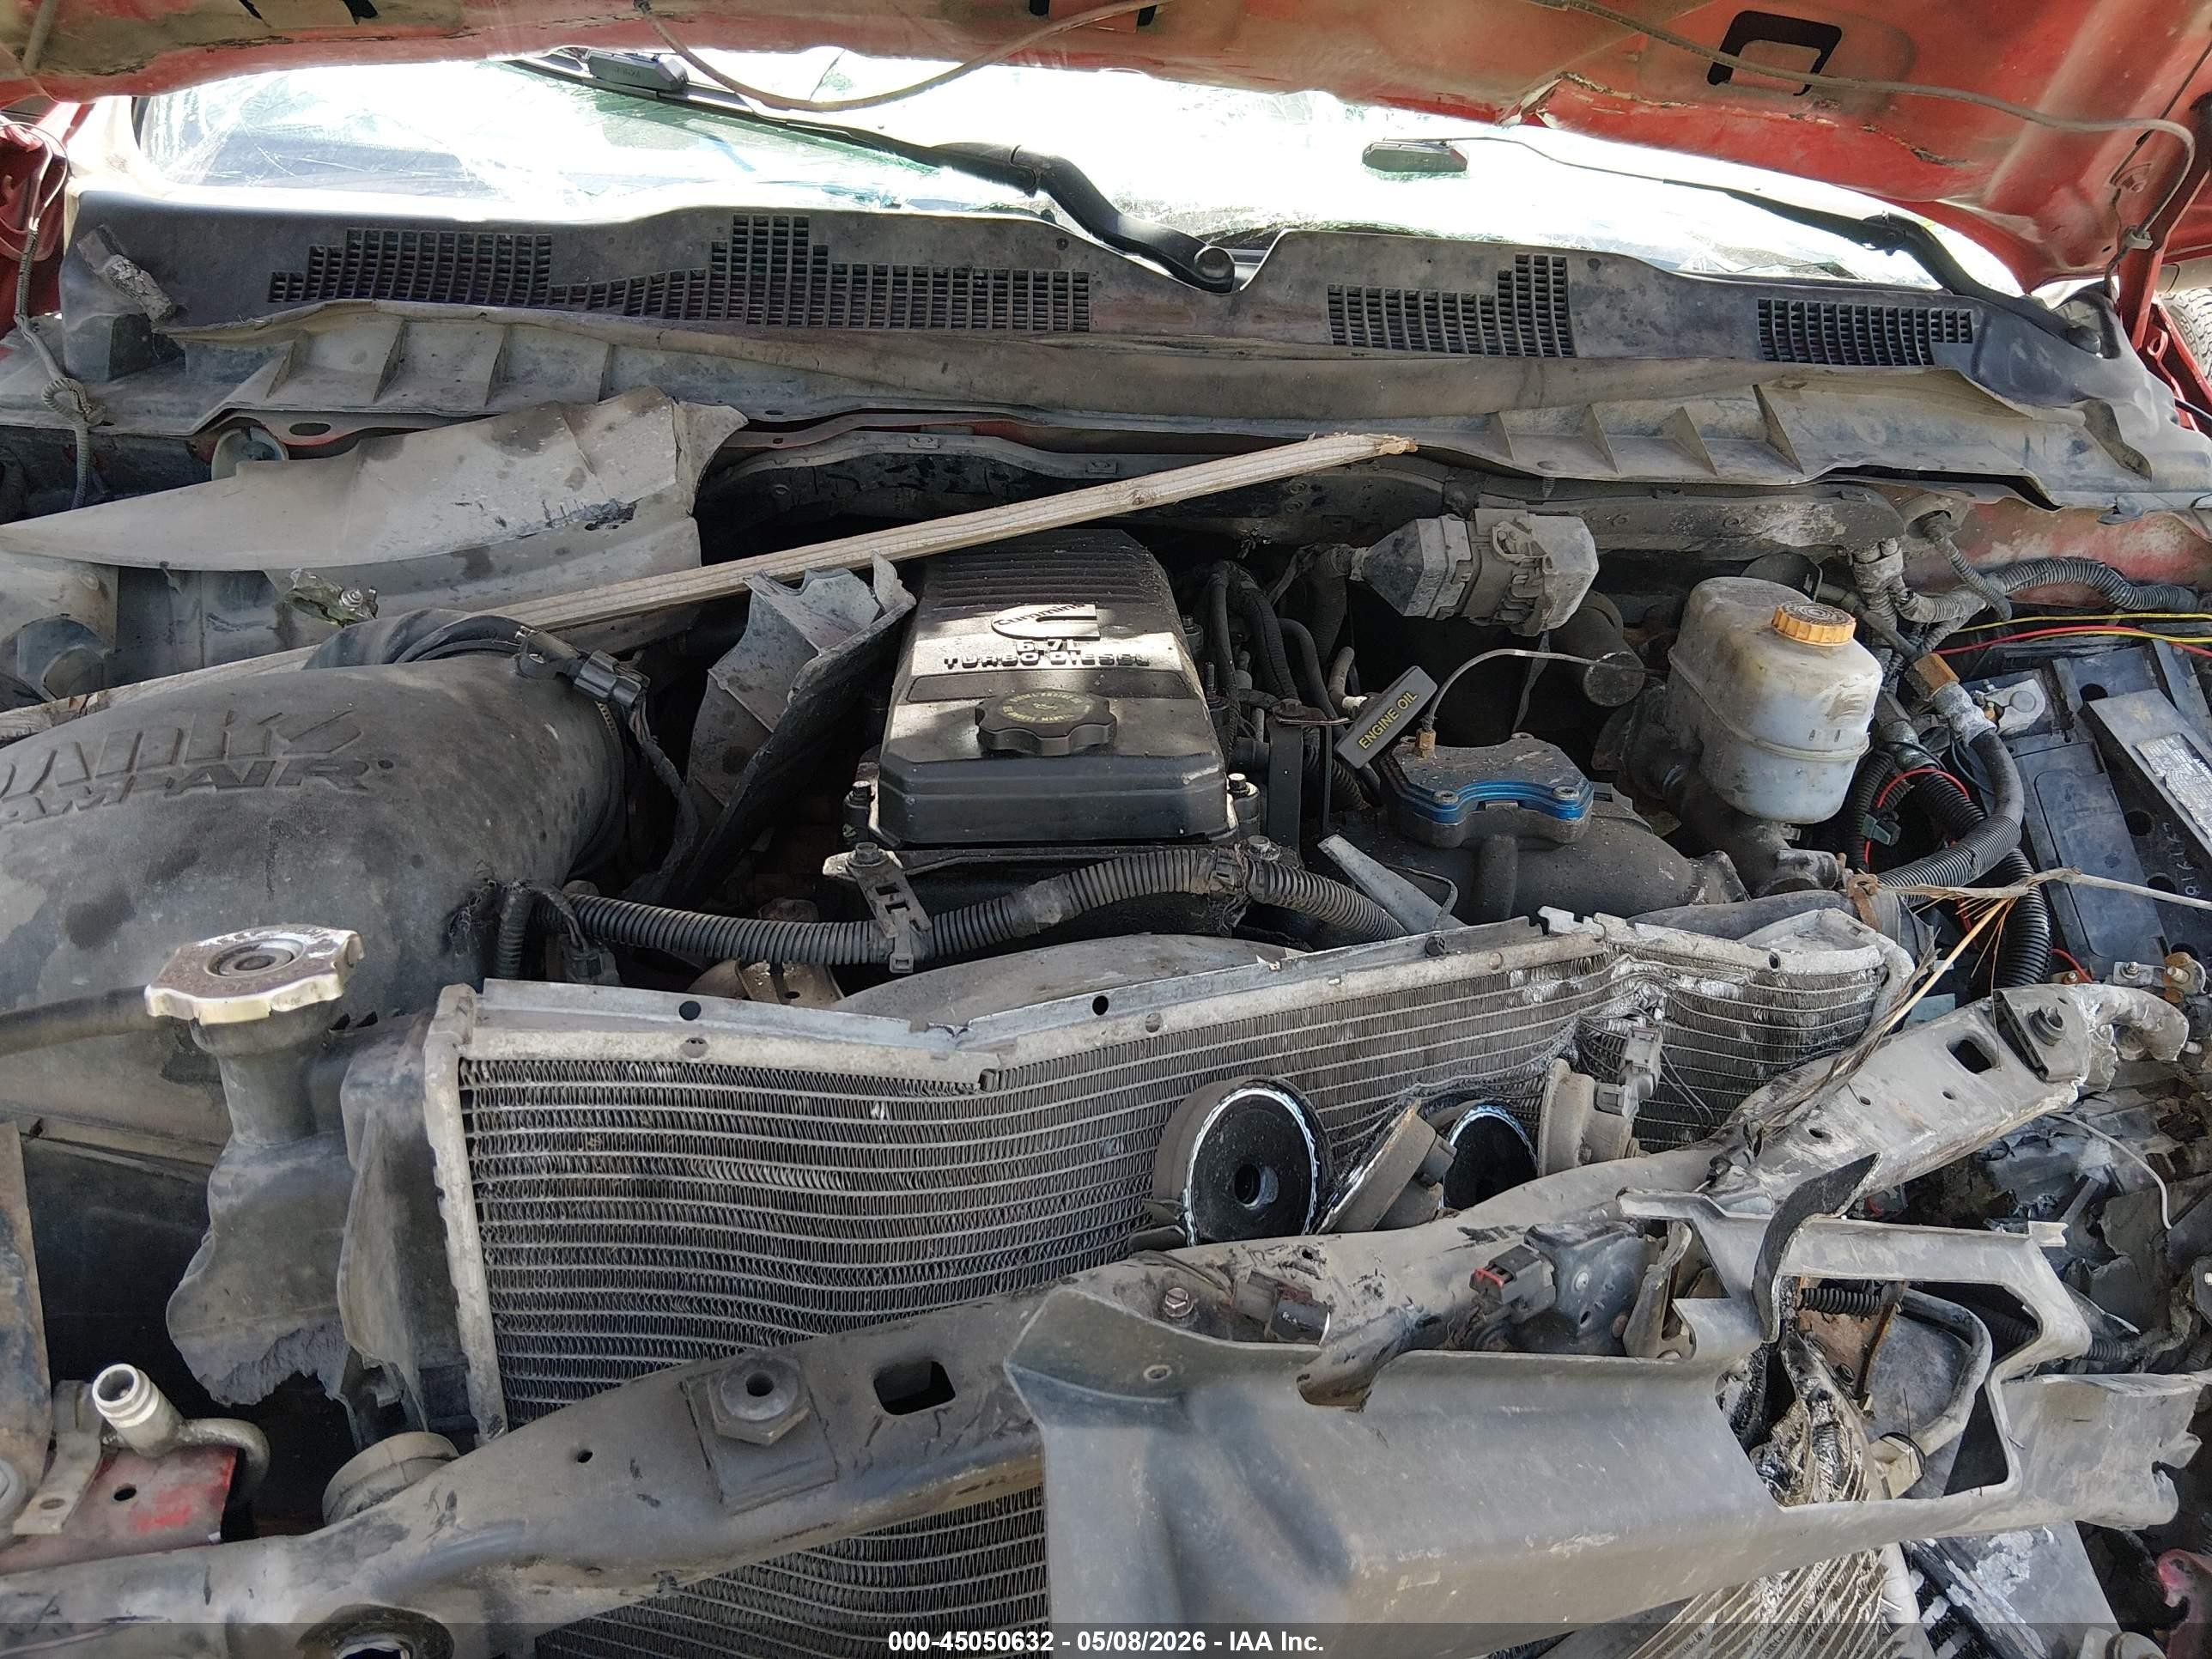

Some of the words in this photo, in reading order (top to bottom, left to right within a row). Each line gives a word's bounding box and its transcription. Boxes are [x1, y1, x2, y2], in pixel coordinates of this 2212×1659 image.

[994, 604, 1085, 626] Cummins
[944, 651, 1041, 669] TURBO
[1049, 650, 1150, 667] DIESEL
[1358, 708, 1399, 750] ENGINE
[1397, 692, 1418, 711] OIL
